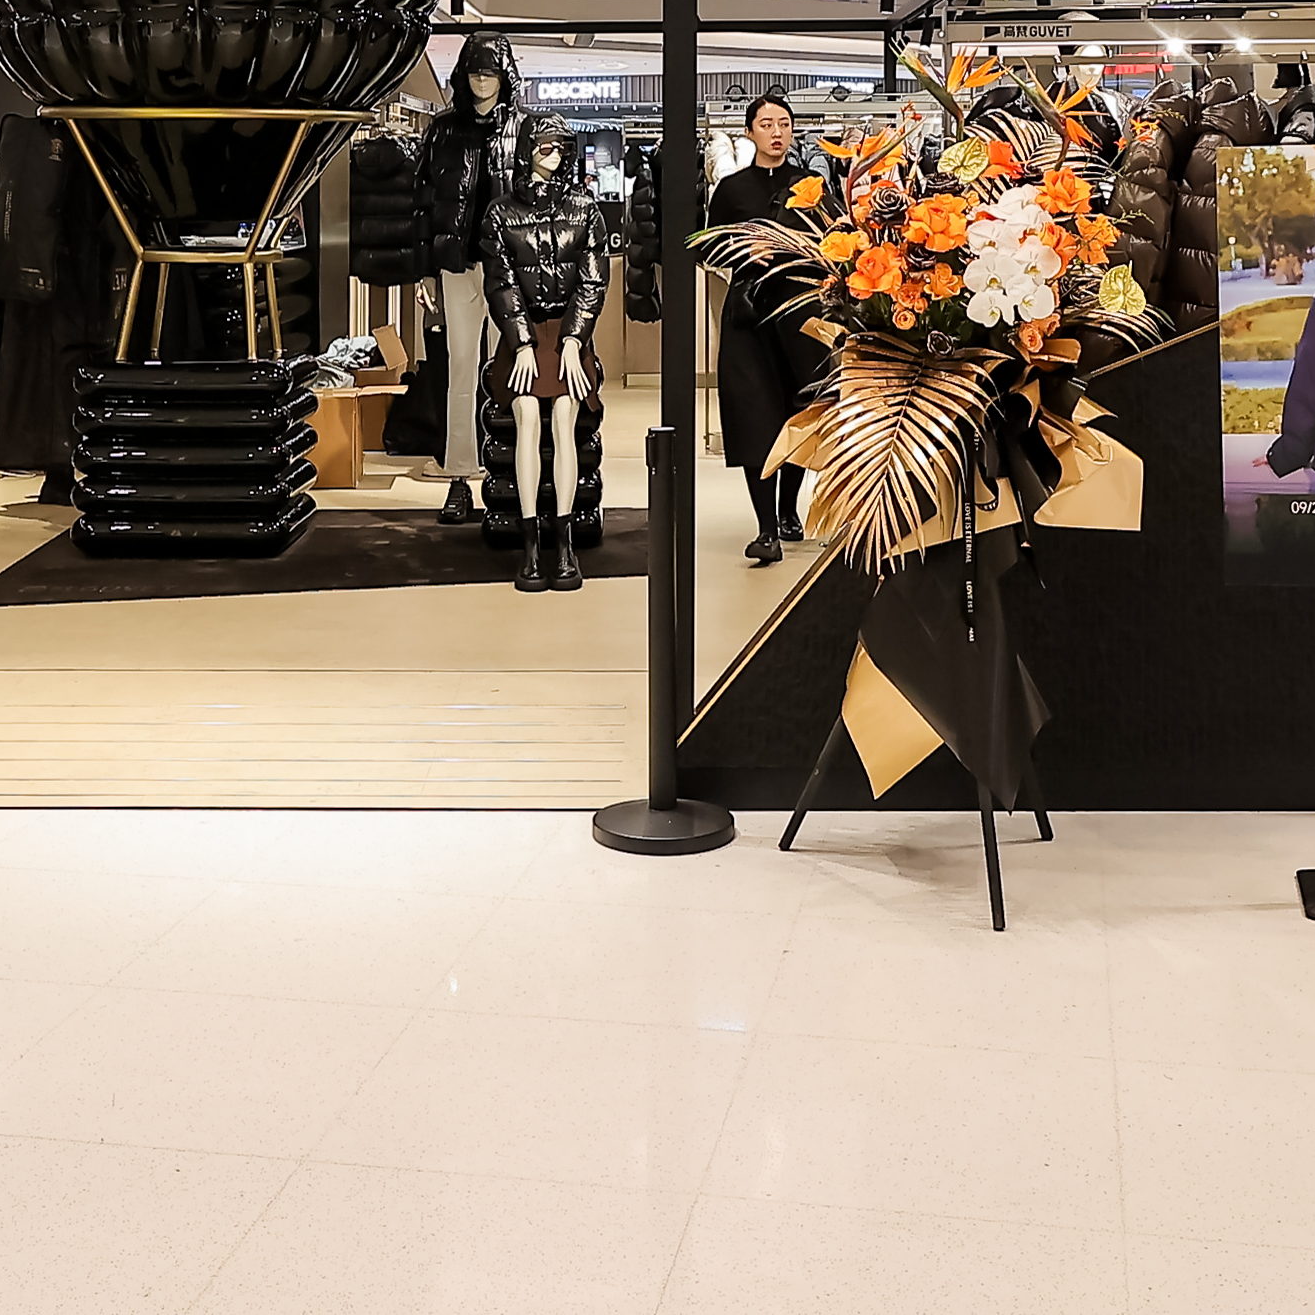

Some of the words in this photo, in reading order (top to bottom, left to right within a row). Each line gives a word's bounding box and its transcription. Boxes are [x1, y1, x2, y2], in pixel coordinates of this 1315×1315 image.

[1029, 25, 1072, 38] GUVET
[538, 81, 620, 100] DESCENTE
[964, 503, 972, 521] LOVE
[965, 531, 973, 563] ETERNAL
[965, 580, 974, 600] LOVE
